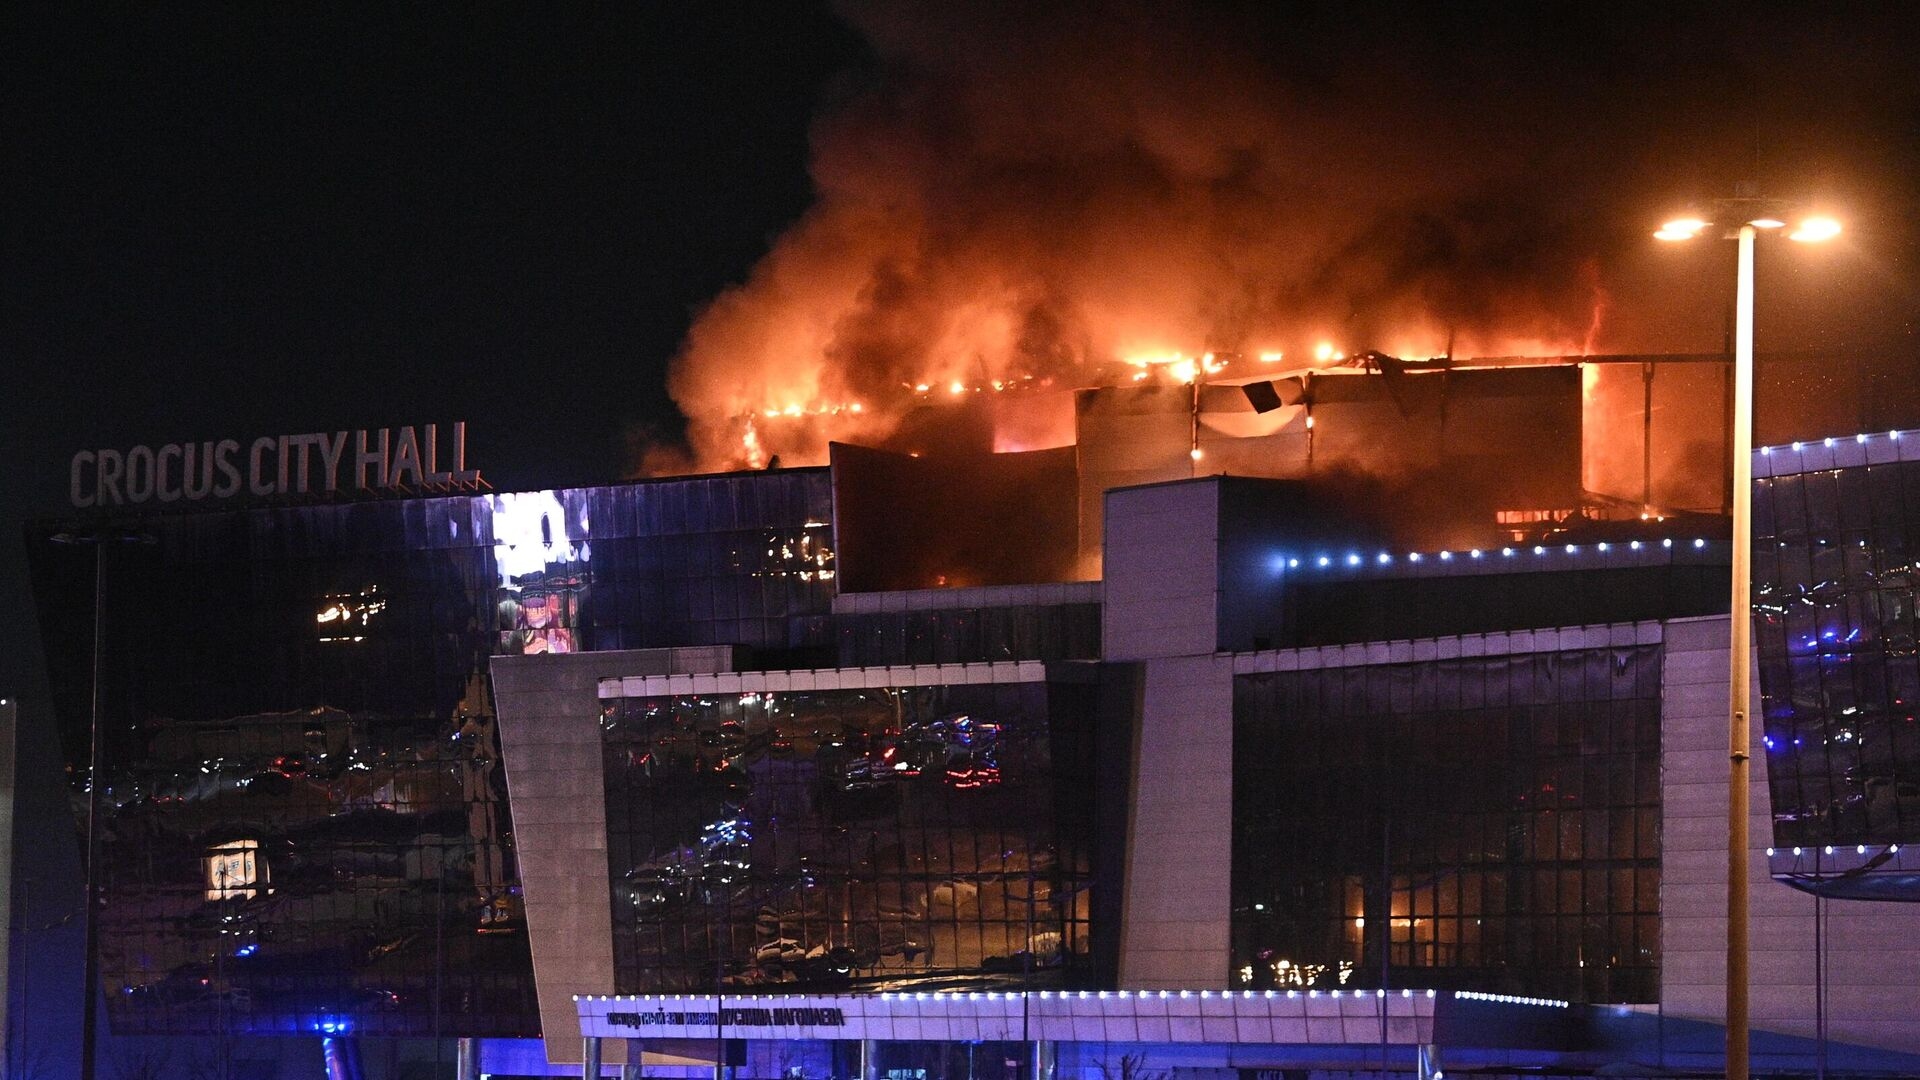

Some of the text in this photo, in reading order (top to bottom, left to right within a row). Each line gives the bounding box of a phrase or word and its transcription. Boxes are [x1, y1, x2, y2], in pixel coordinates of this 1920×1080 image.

[70, 421, 480, 508] CROCUS CITY HALL
